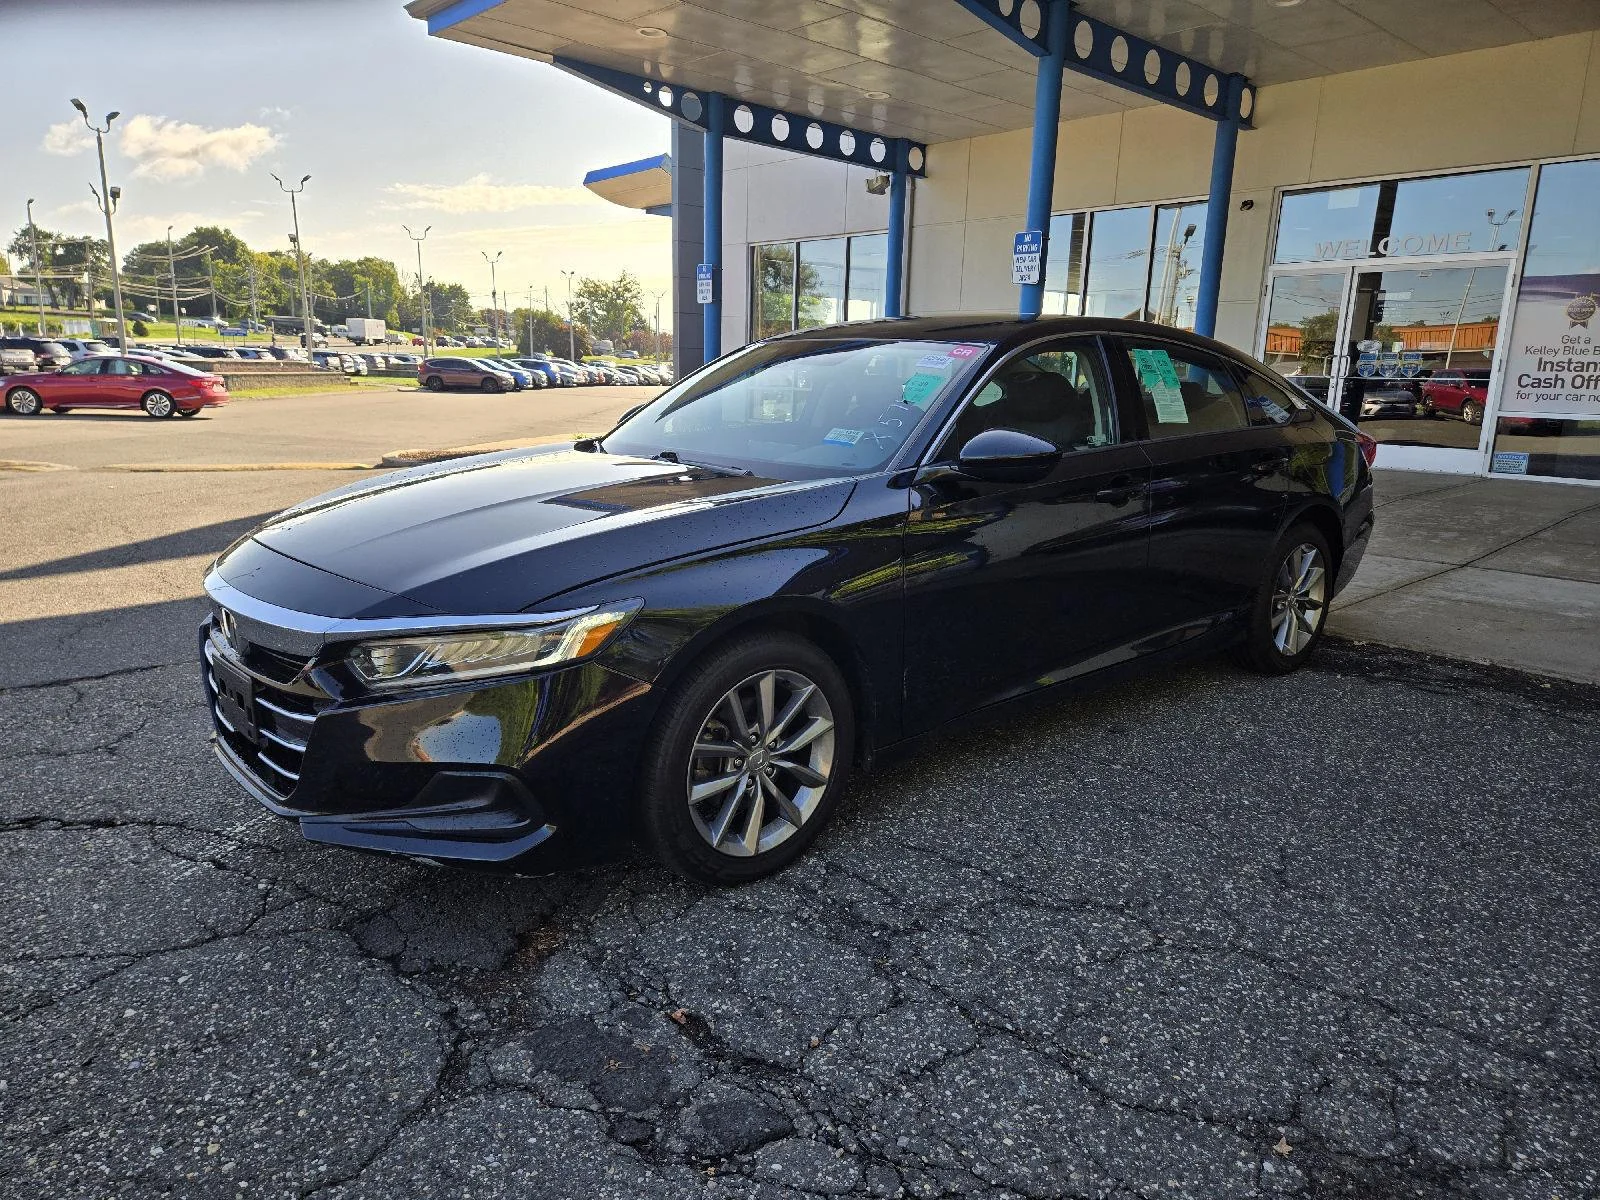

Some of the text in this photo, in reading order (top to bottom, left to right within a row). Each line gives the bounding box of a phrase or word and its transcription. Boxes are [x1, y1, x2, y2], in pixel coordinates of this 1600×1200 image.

[1317, 231, 1473, 258] WELCOME
[1561, 334, 1591, 345] Get a
[1525, 345, 1561, 358] Kelley
[1562, 345, 1590, 356] Blue
[1517, 373, 1566, 389] Cash
[1516, 389, 1533, 400] for
[1534, 392, 1562, 403] your
[1565, 393, 1586, 402] car
